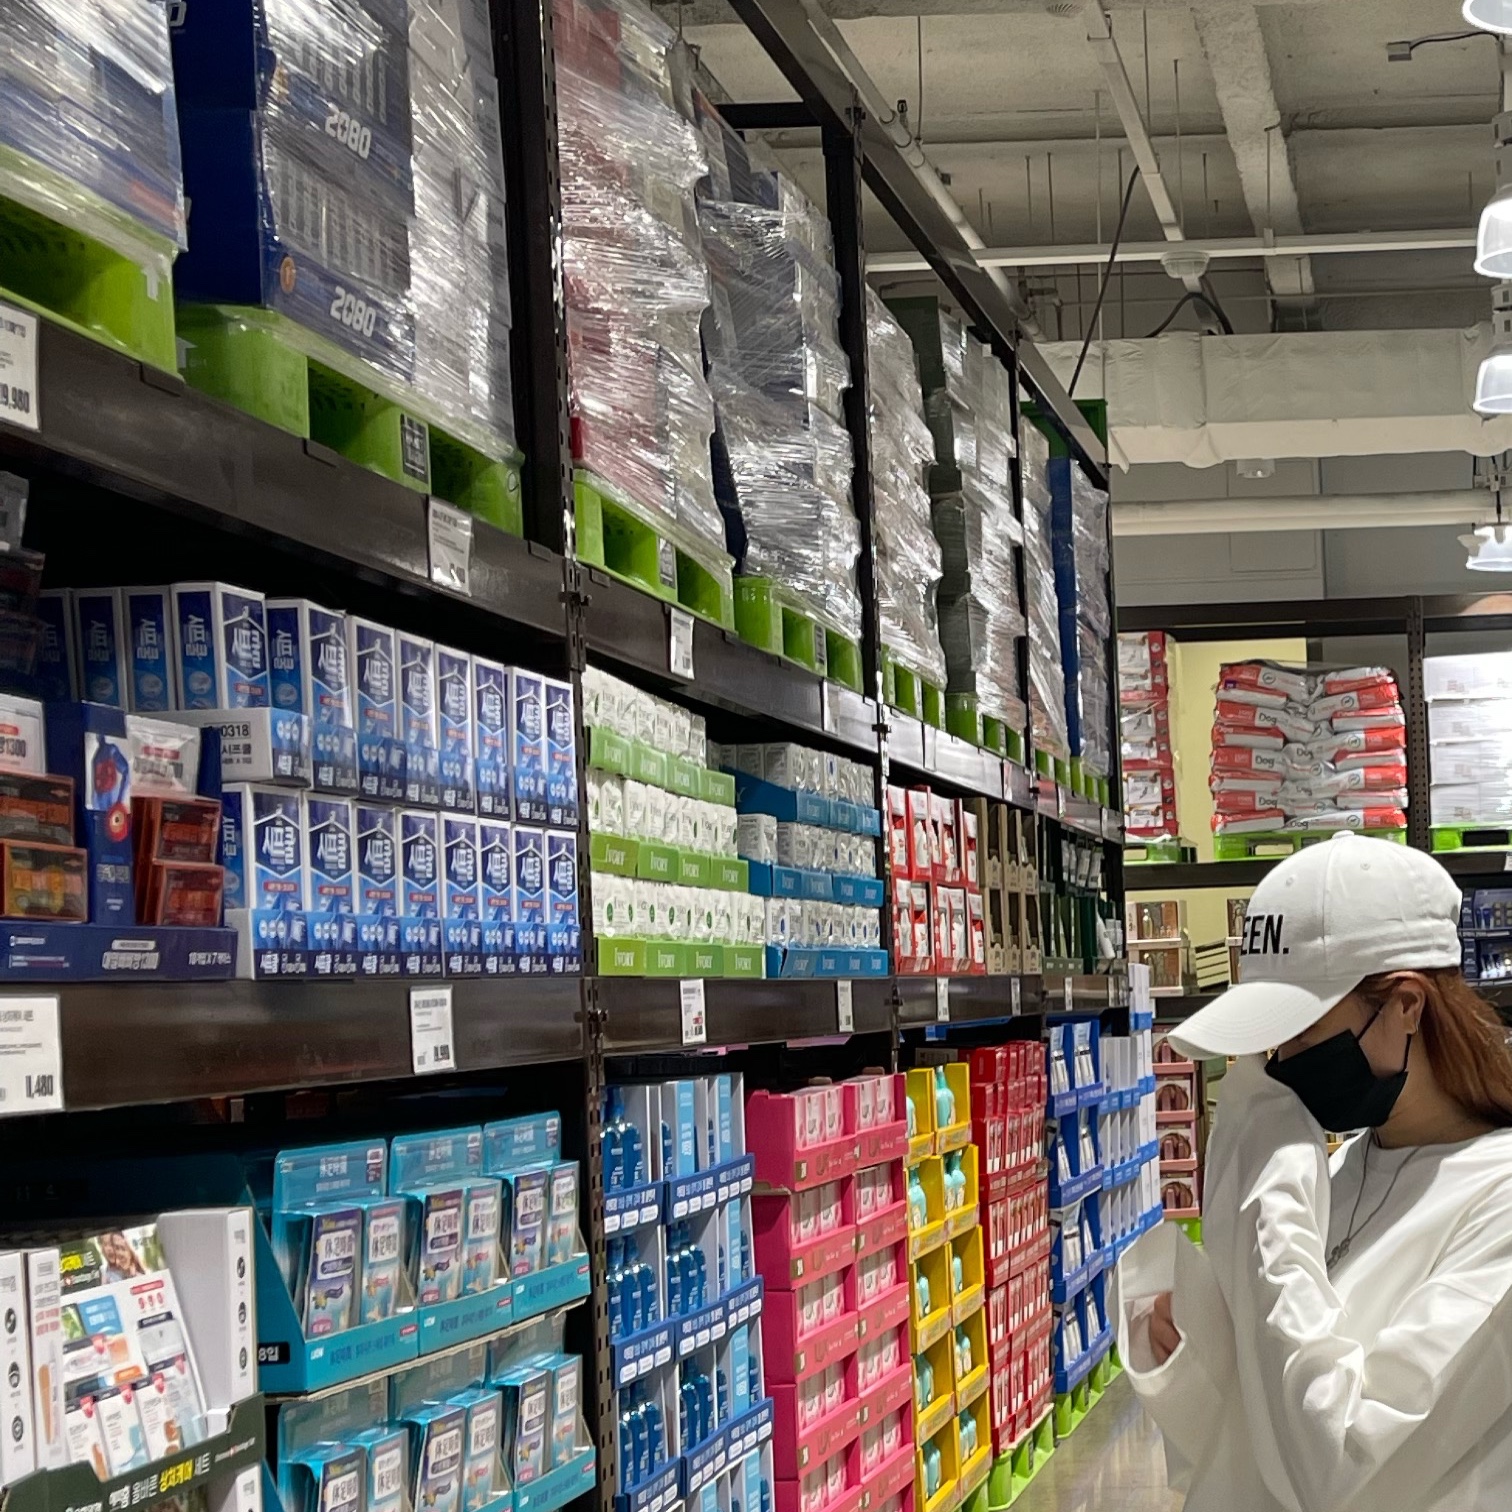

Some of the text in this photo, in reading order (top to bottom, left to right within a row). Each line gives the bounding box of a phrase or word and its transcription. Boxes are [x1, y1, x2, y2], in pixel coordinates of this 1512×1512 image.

[325, 107, 371, 159] 2080
[330, 286, 376, 338] 2080
[1259, 712, 1277, 725] Dog
[1255, 755, 1274, 768] Dog
[1259, 796, 1277, 809] Dog
